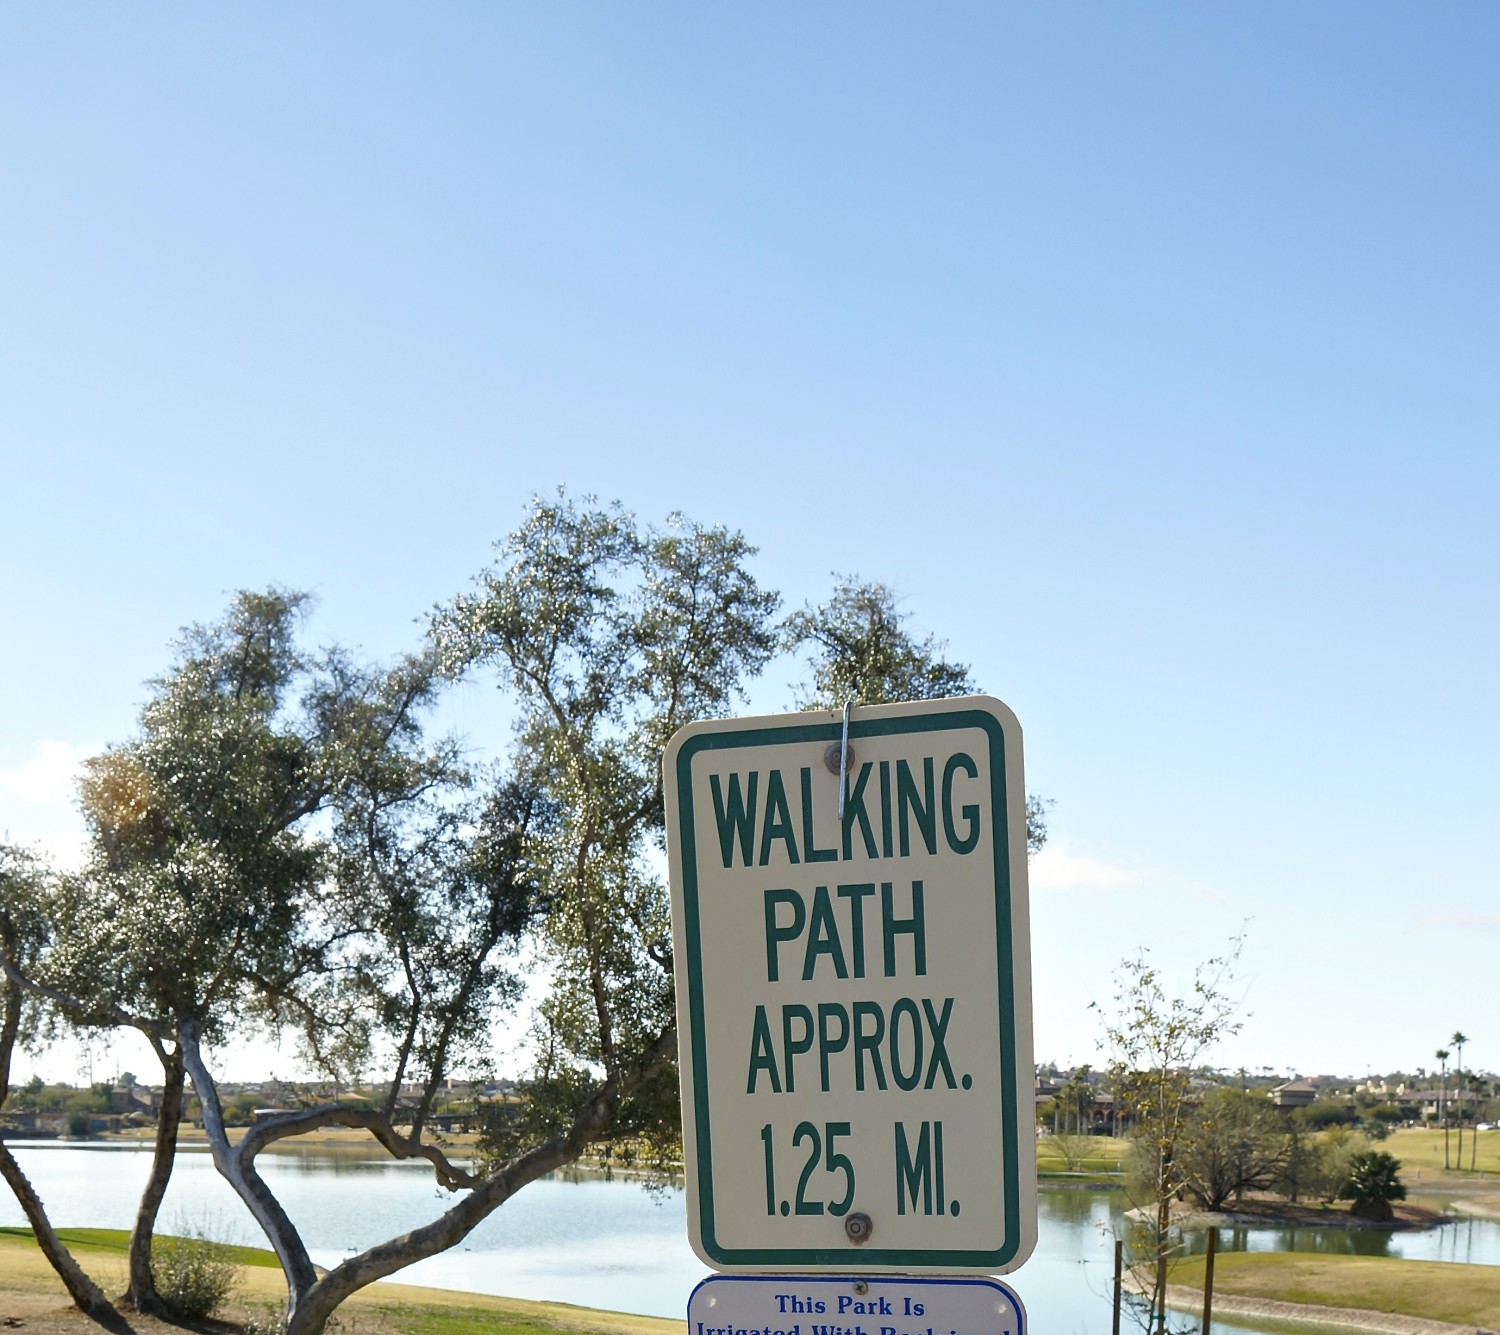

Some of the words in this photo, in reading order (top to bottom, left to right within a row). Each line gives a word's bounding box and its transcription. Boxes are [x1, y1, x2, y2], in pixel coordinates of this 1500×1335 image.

[709, 752, 980, 869] WALKING
[764, 880, 926, 982] PATH
[746, 997, 973, 1095] APPROX.
[761, 1120, 855, 1217] 1.25
[894, 1120, 961, 1217] MI.
[775, 1294, 826, 1315] This
[837, 1295, 892, 1316] Park
[903, 1297, 925, 1317] Is
